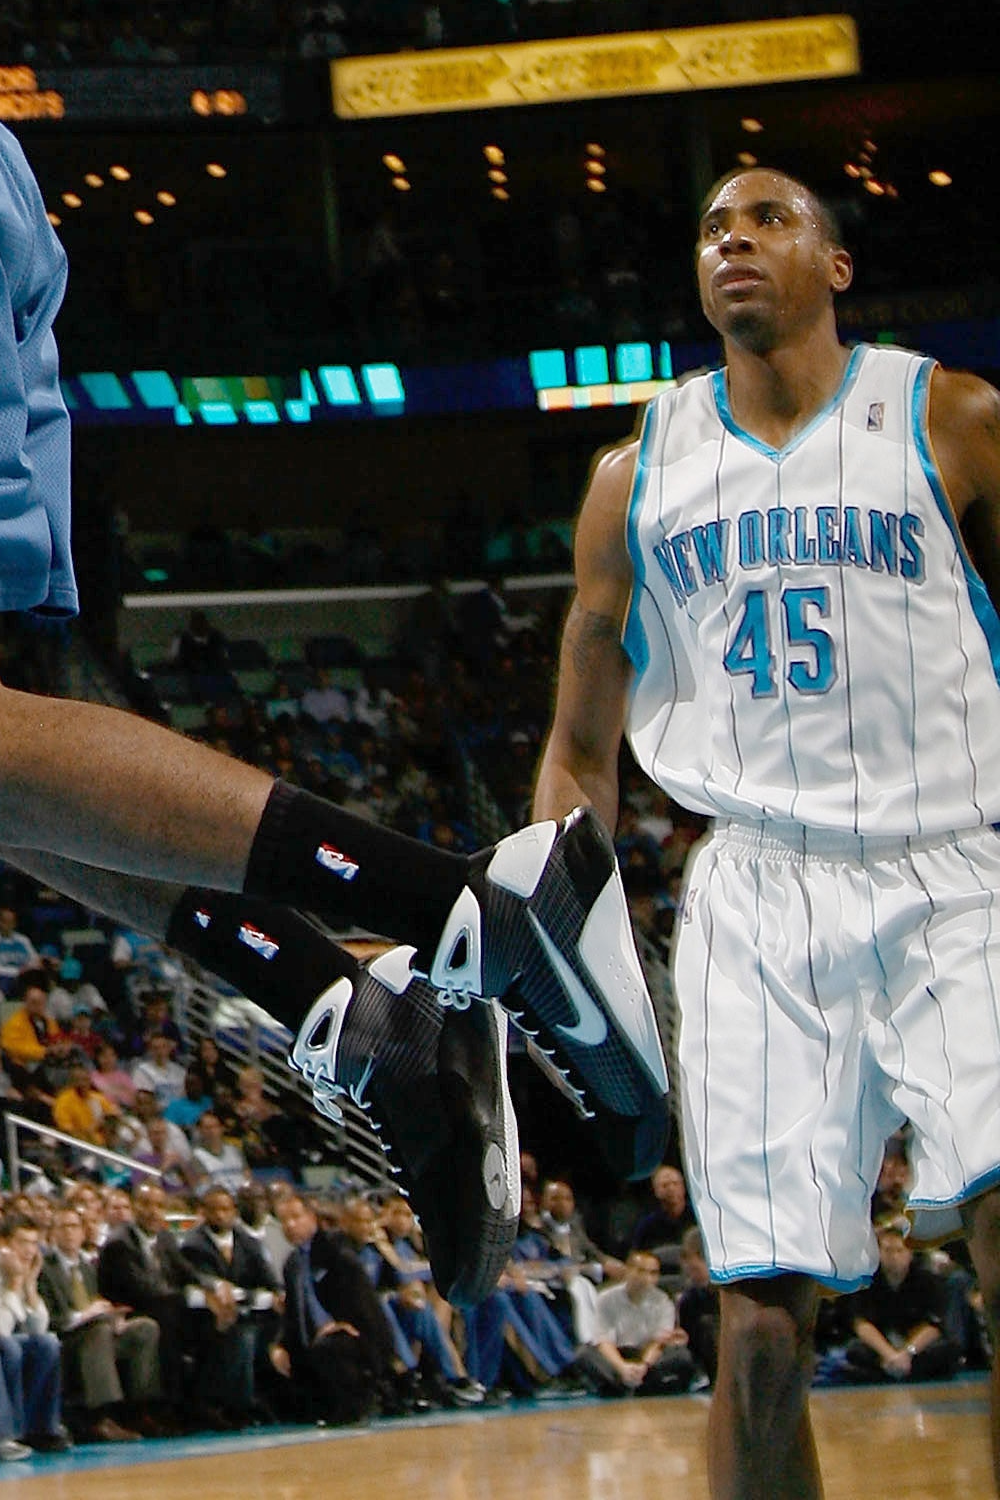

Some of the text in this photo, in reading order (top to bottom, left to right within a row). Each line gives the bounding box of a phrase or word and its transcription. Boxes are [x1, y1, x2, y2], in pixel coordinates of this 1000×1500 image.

[653, 506, 927, 608] NEW ORLEANS
[723, 586, 838, 698] 45
